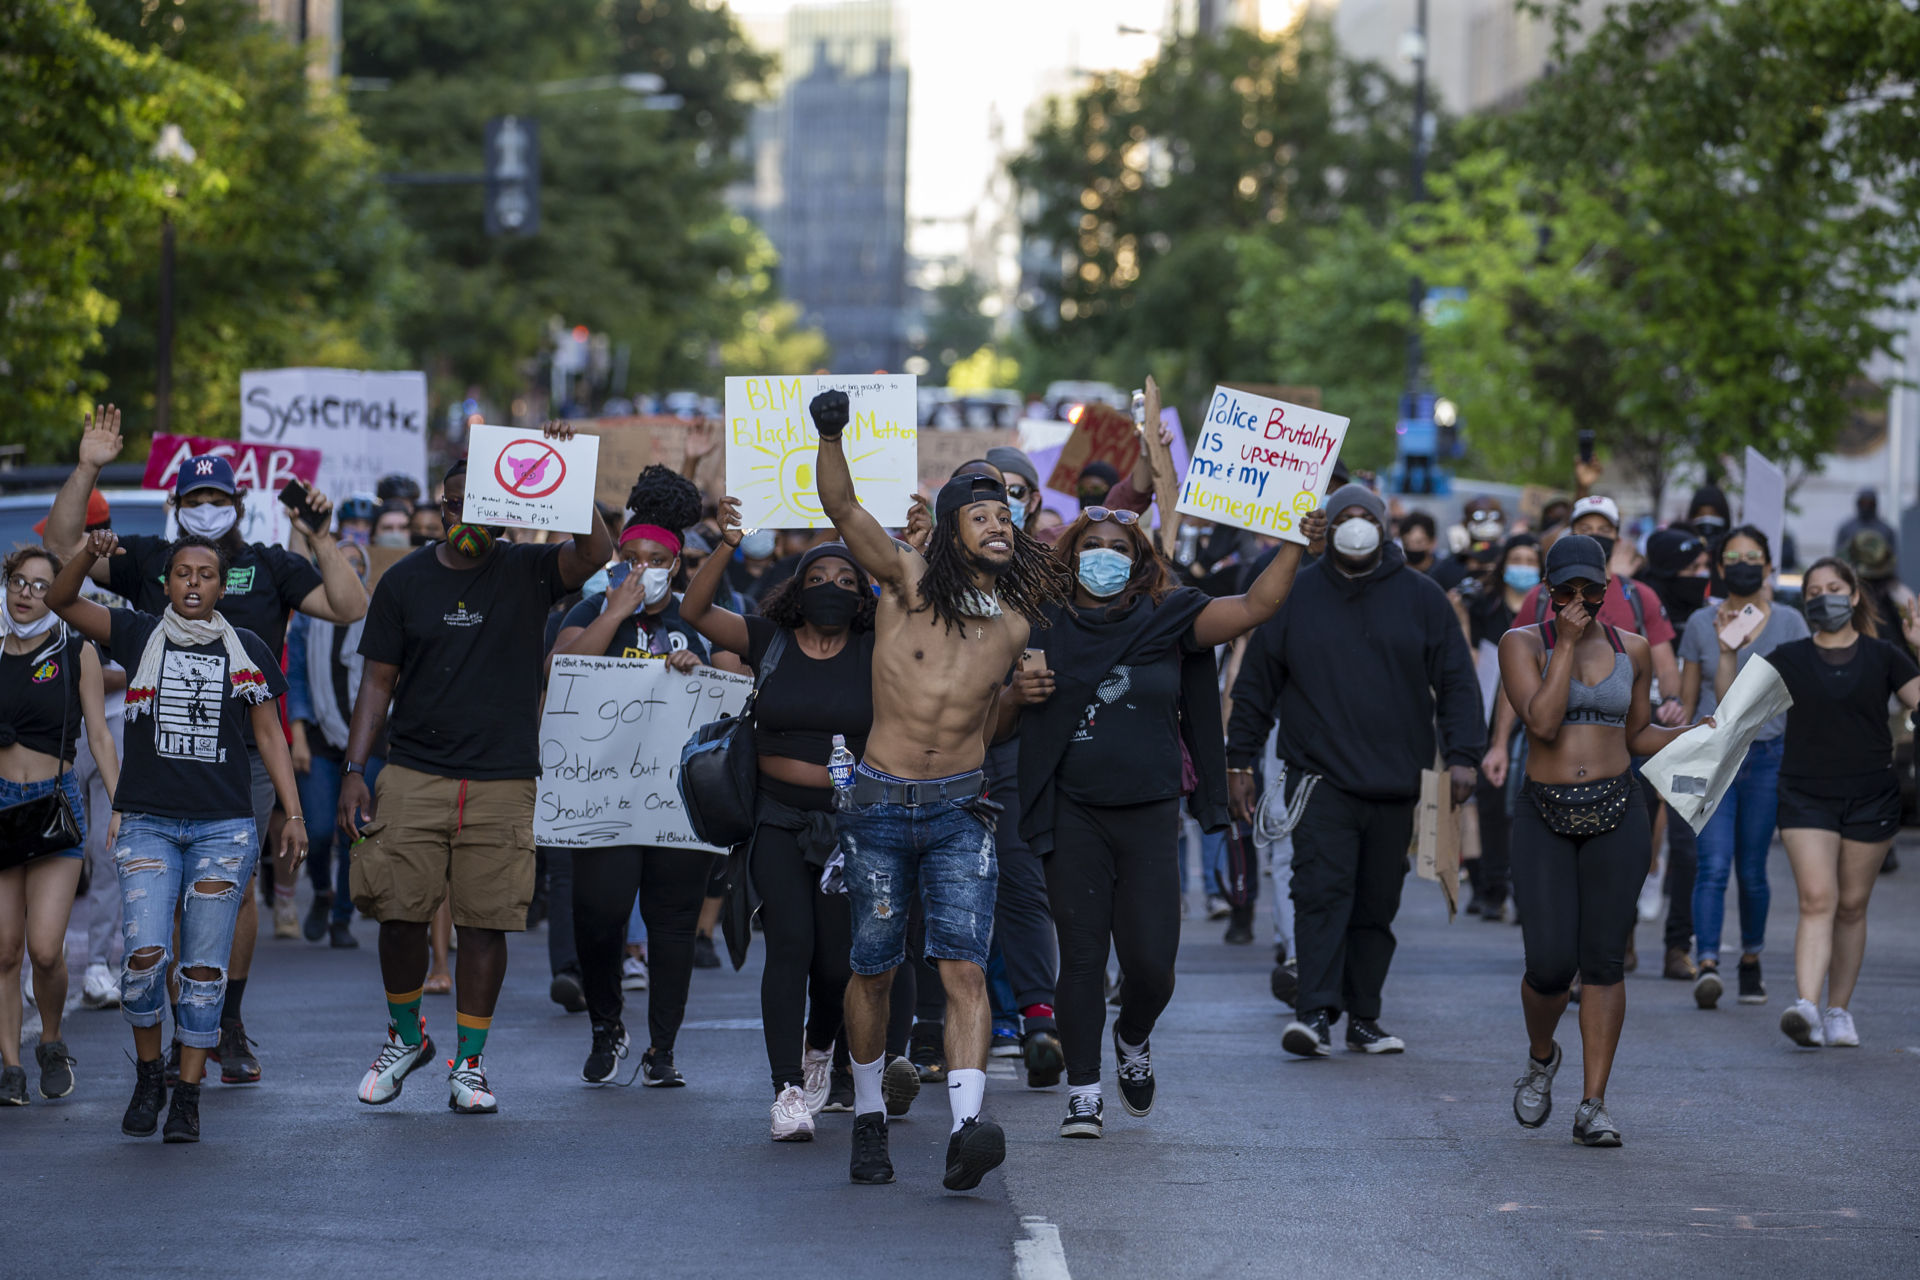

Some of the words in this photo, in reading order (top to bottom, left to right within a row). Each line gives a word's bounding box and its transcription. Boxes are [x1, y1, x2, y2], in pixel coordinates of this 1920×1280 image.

[246, 387, 420, 440] Systematic
[746, 378, 803, 414] BLM
[732, 417, 799, 447] Black
[1208, 392, 1258, 432] Police
[1263, 407, 1336, 466] Brutality
[1191, 456, 1223, 480] me
[1239, 466, 1270, 498] my
[1240, 444, 1319, 492] upsetting
[1183, 481, 1292, 532] Homegirls
[547, 673, 589, 715] I
[580, 688, 668, 742] got
[685, 681, 726, 729] 99
[159, 732, 192, 755] LIFE
[541, 738, 619, 783] Problems
[630, 742, 660, 779] but
[618, 795, 632, 809] be
